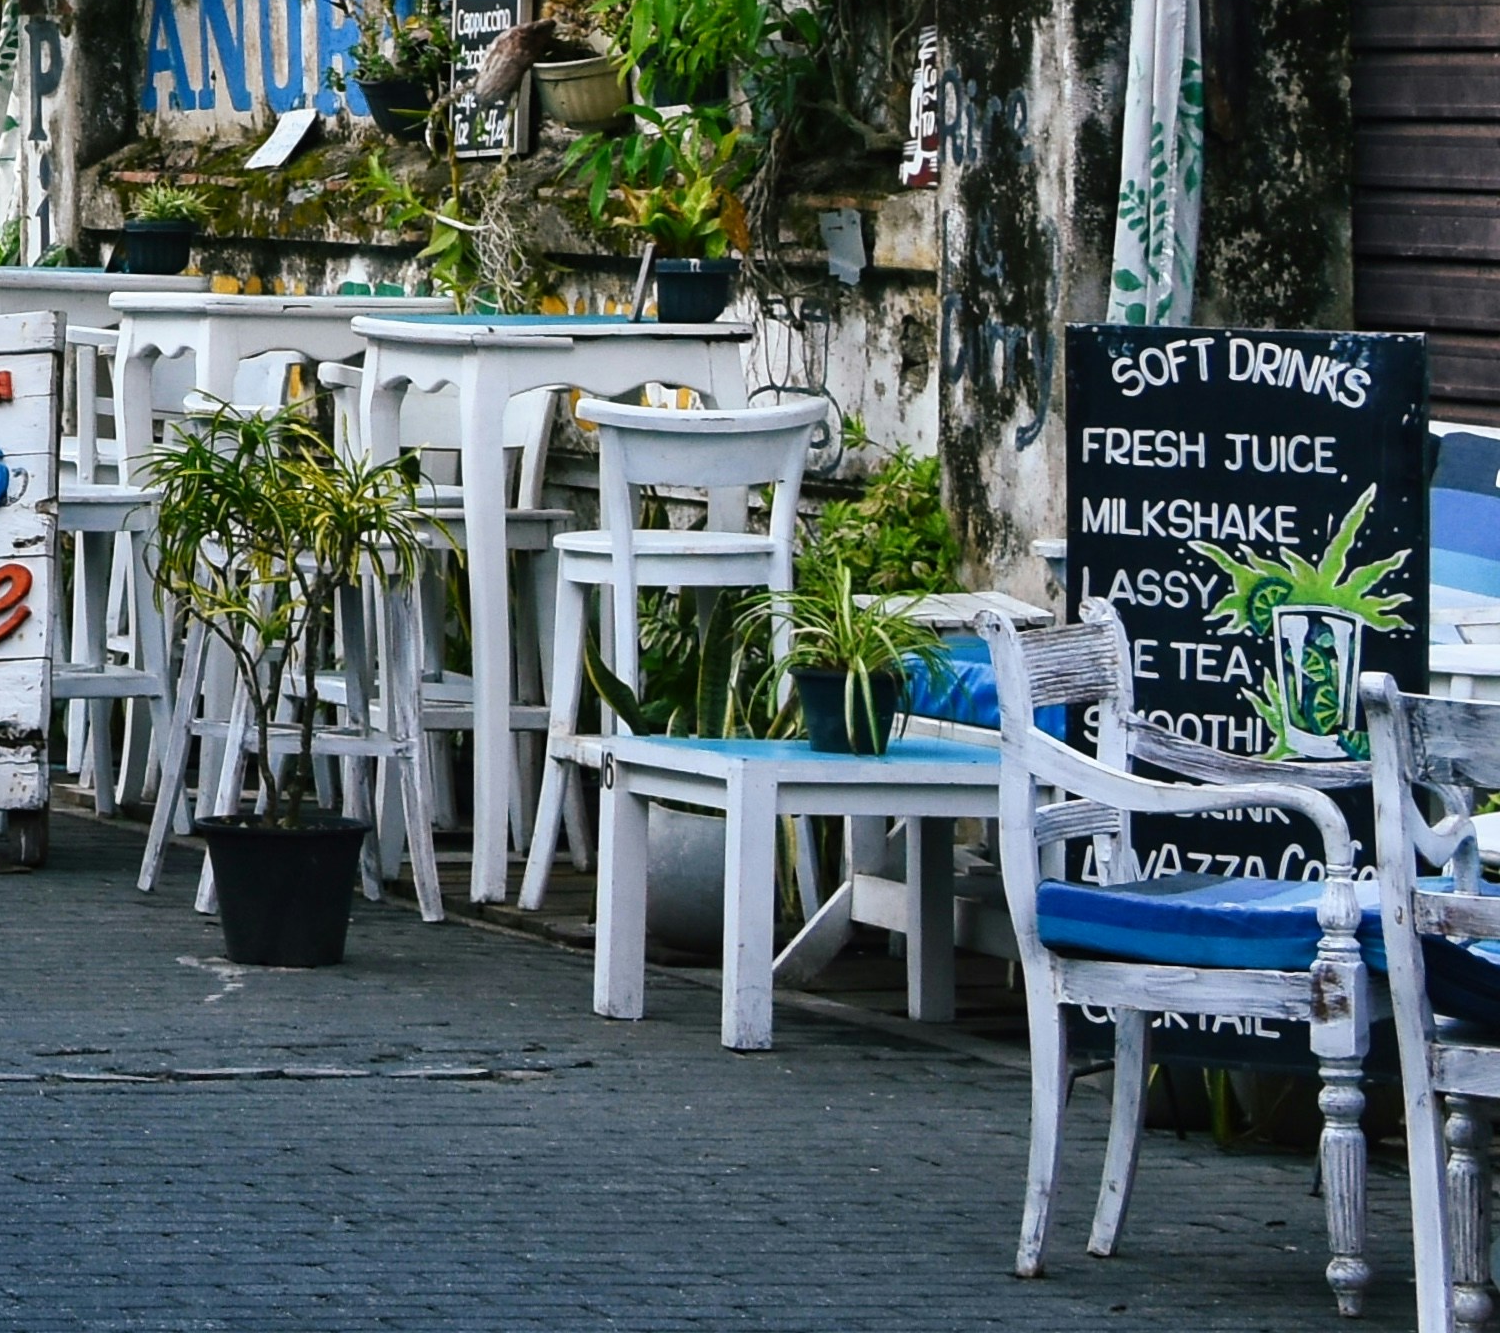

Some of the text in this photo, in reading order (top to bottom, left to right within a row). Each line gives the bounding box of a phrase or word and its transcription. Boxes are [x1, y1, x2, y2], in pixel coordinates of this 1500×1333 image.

[456, 3, 512, 39] Cappuccino
[1111, 337, 1372, 409] SOFT DRINKS
[1082, 427, 1338, 473] FRESH JUICE
[1081, 496, 1300, 544] MILKSHAKE
[1081, 566, 1219, 610] LASSY
[1170, 642, 1253, 683] TEA
